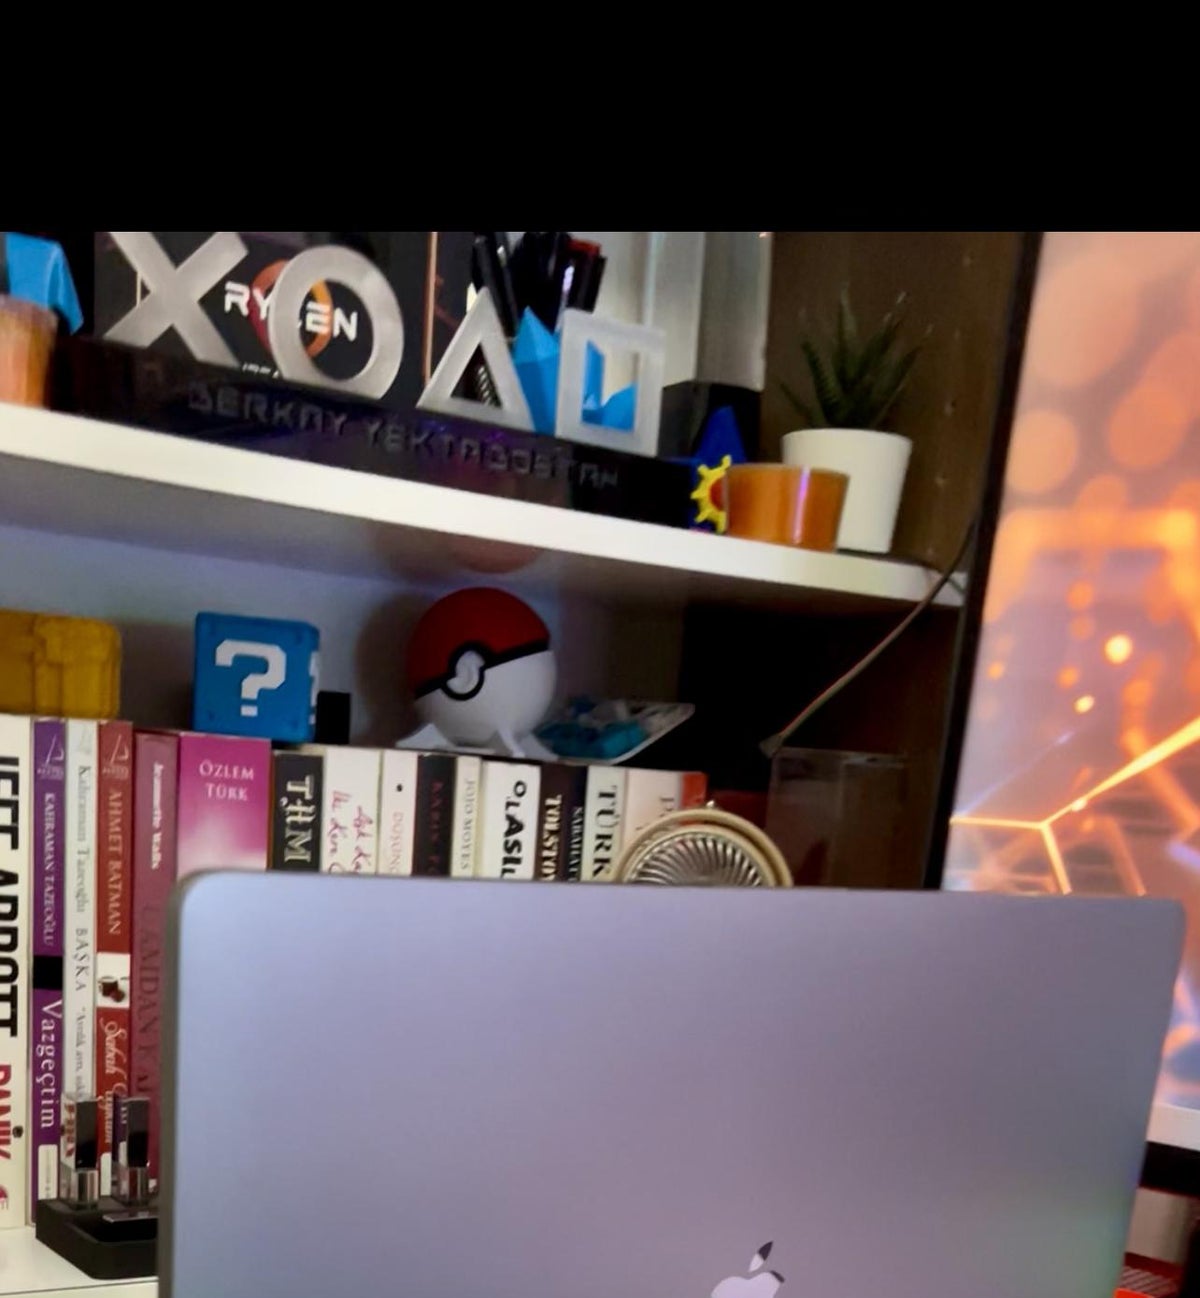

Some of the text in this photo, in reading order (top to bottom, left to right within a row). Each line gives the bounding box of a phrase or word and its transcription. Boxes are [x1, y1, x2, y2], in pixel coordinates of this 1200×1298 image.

[224, 280, 359, 342] RYEN
[199, 758, 254, 781] ÖZLEM
[205, 782, 248, 802] TÜRK
[107, 789, 123, 852] AHMET
[461, 818, 474, 870] MOYES
[107, 860, 123, 936] BATMAN
[36, 999, 63, 1129] Vazgeçtim
